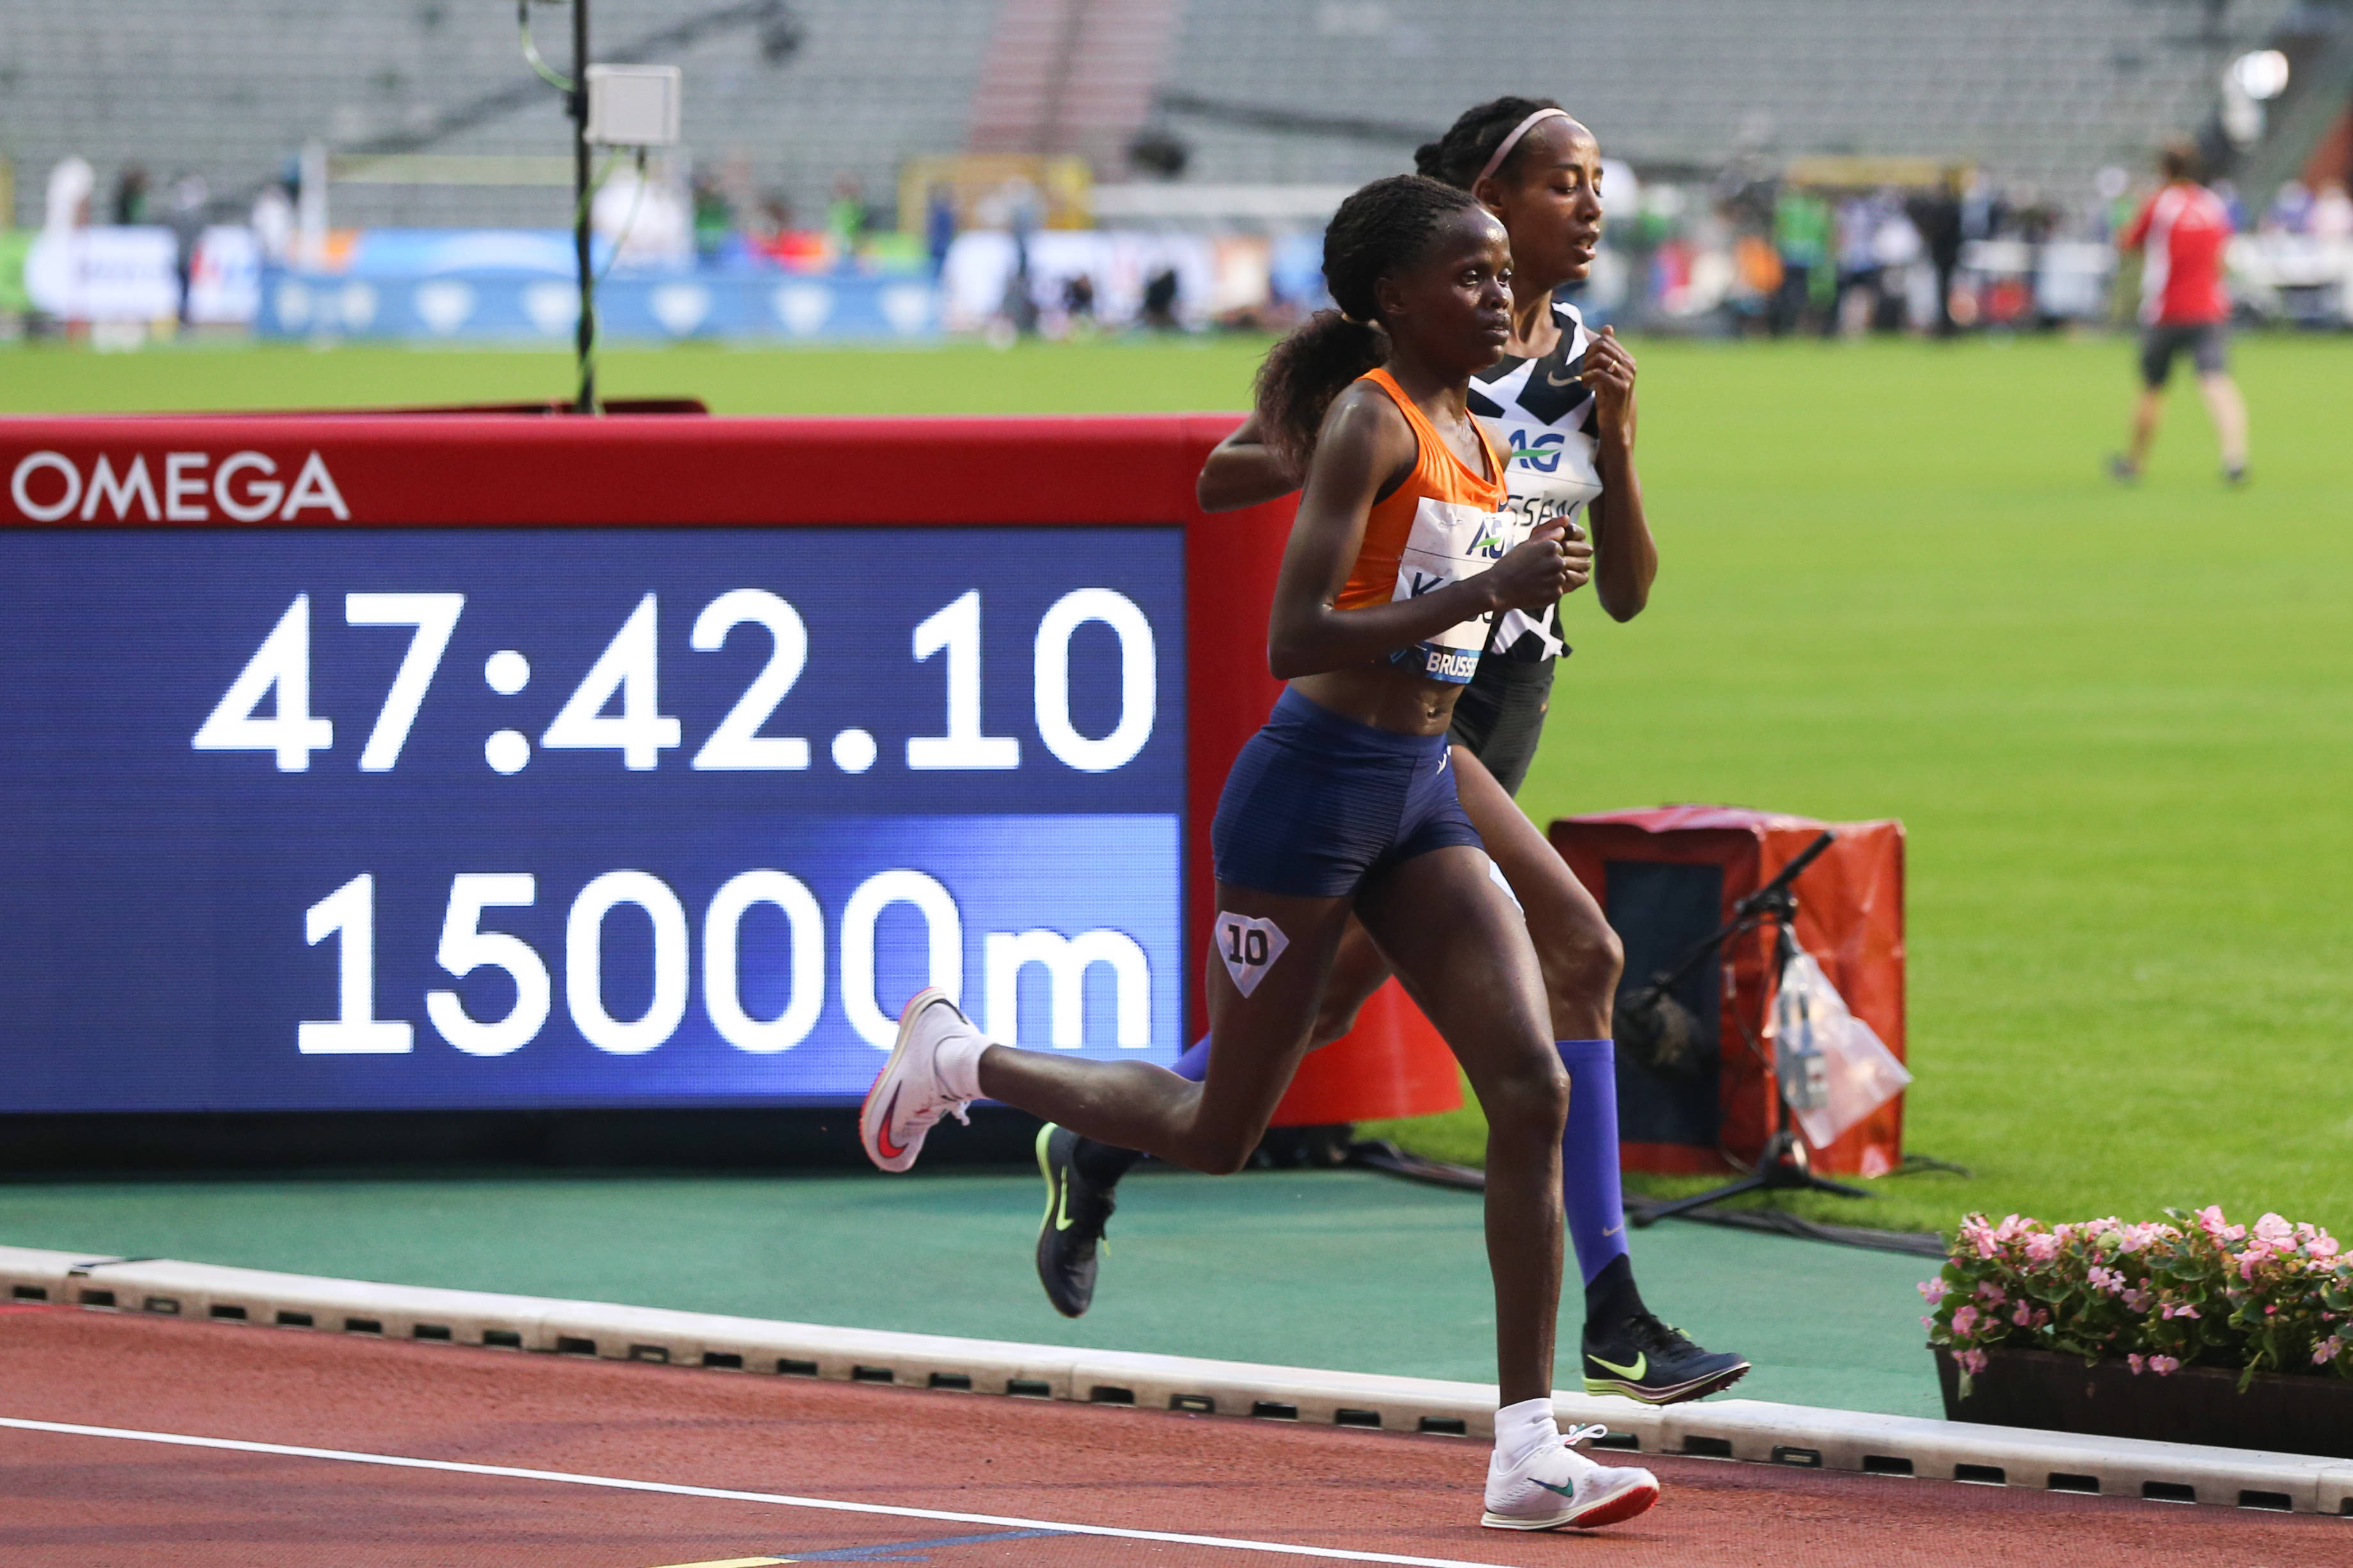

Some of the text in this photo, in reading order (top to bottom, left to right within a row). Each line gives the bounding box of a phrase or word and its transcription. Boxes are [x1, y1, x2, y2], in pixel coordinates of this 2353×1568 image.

[11, 450, 350, 522] OMEGA
[192, 588, 1157, 774] 47:42.10
[297, 869, 1151, 1056] 15000m
[1229, 923, 1268, 966] 10
